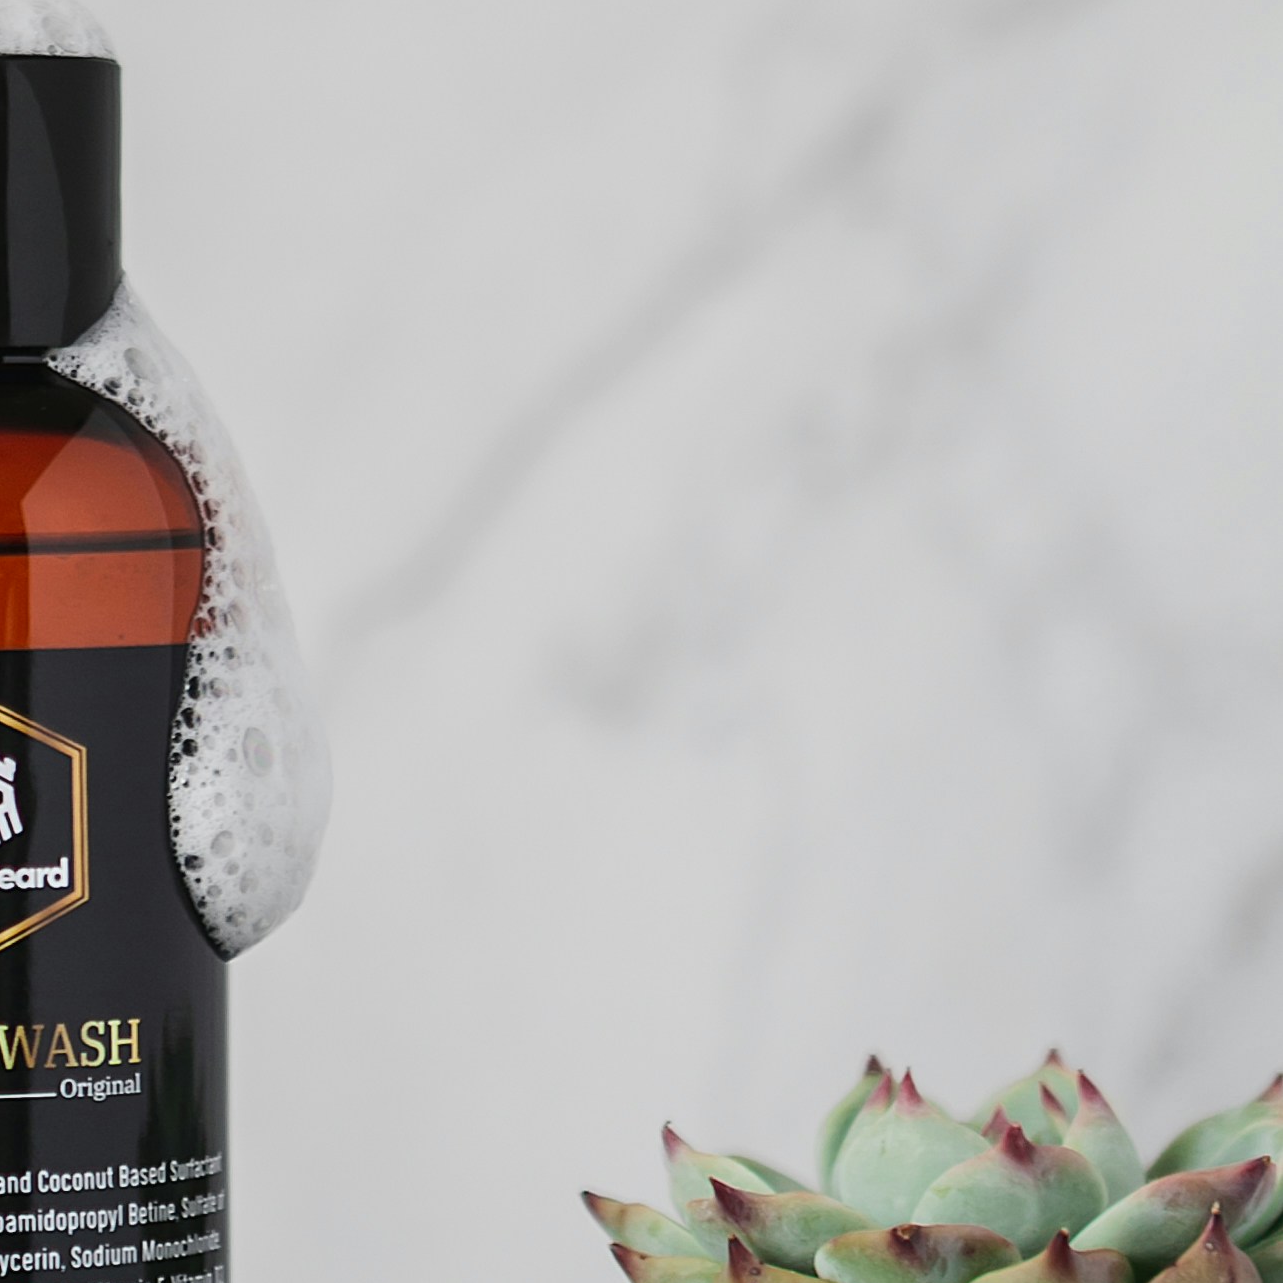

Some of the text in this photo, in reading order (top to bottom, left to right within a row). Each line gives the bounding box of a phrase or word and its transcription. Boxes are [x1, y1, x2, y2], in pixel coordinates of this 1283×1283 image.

[60, 1073, 141, 1101] Original
[38, 1167, 114, 1193] Coconut
[119, 1162, 166, 1188] Based
[129, 1201, 179, 1225] Betine,
[71, 1244, 137, 1268] Sodium
